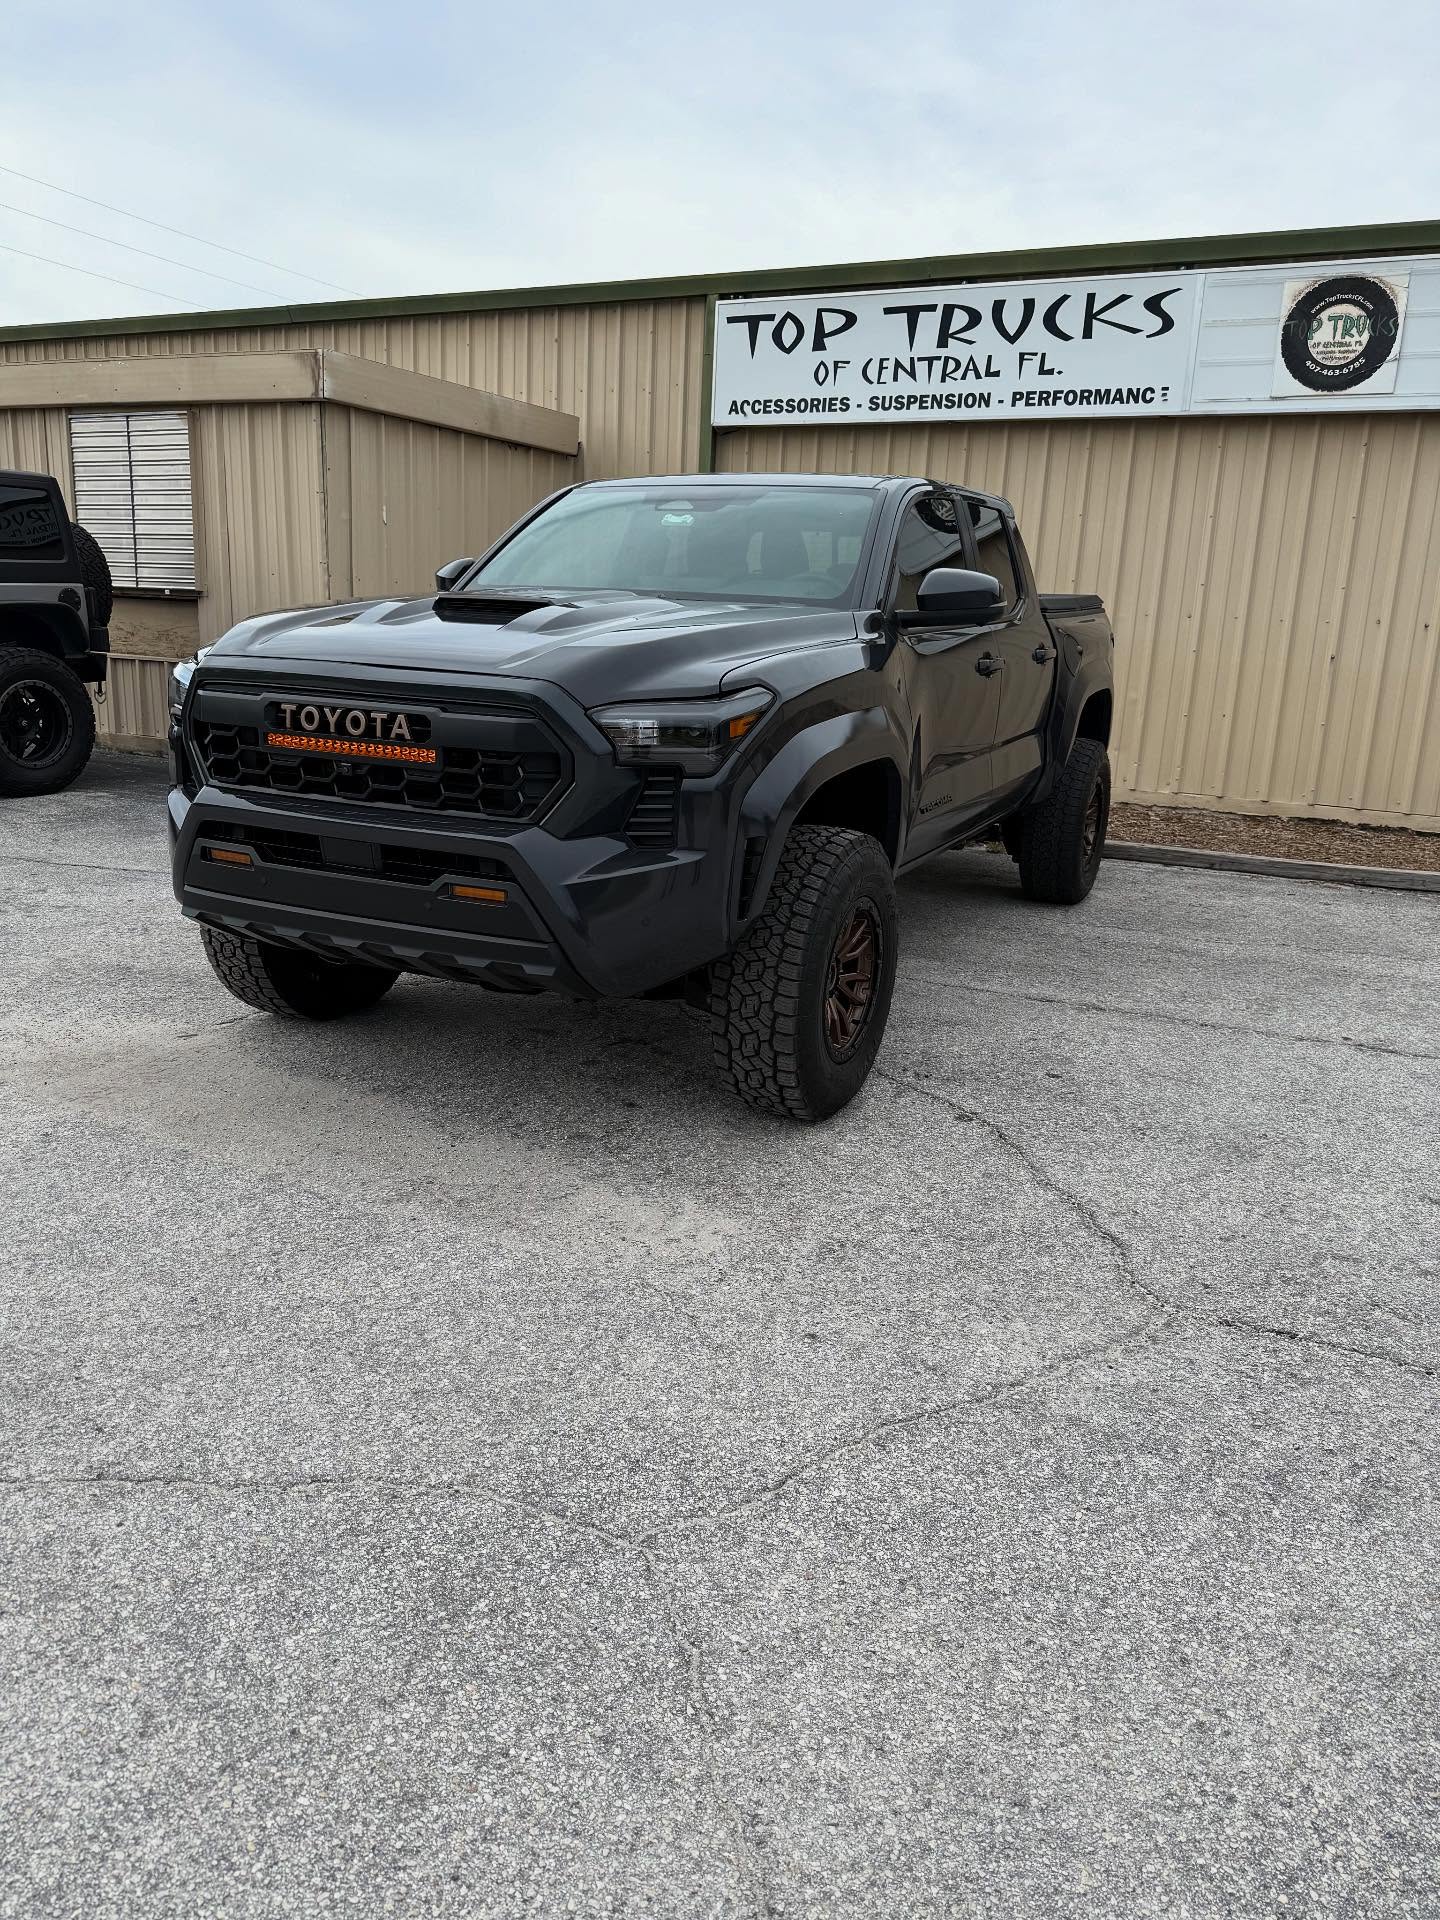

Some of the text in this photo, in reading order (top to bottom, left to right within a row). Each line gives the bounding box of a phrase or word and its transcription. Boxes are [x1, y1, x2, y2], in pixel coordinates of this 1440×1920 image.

[726, 287, 1184, 360] TOP TRUCKS
[1285, 314, 1398, 341] TOP TRUCKS
[814, 352, 1064, 387] OF CENTRAL FL.
[1305, 357, 1366, 376] 407-463-6785
[728, 396, 851, 417] ACCESSORIES
[868, 391, 992, 412] SUSPENSION
[280, 703, 413, 741] TOYOTA
